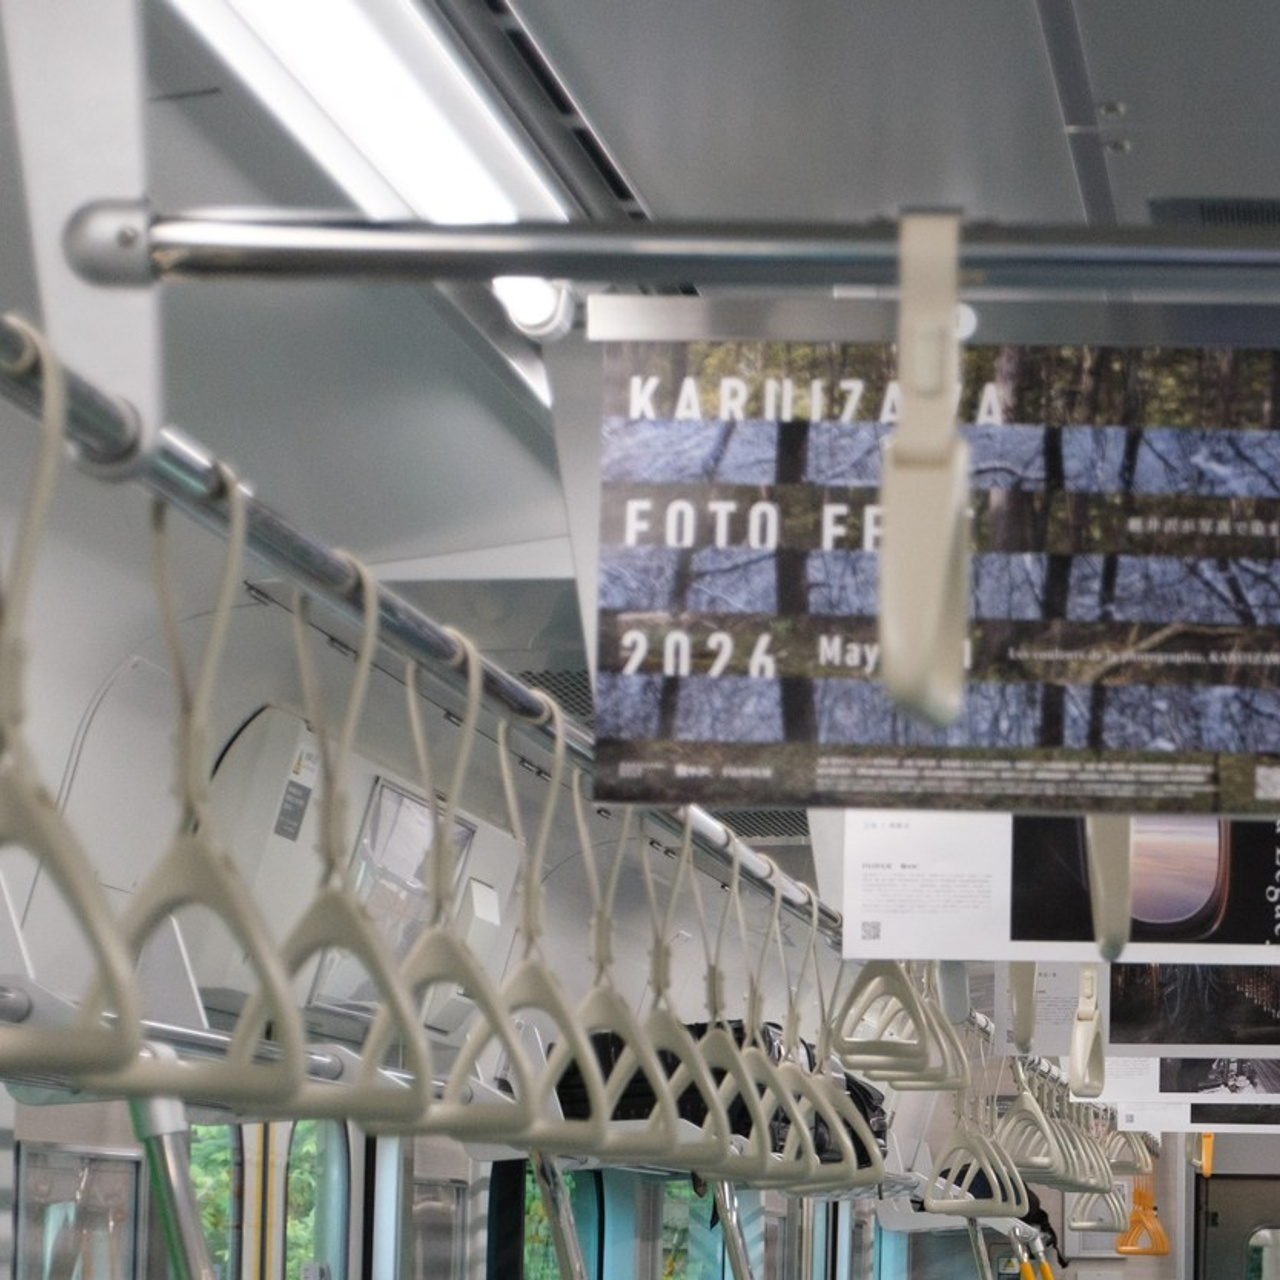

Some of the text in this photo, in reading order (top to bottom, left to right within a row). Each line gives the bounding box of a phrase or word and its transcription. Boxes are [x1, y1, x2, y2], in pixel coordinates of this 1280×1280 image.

[628, 375, 1004, 425] KARUIZAA
[625, 499, 780, 550] FOTO
[621, 630, 777, 679] 2026
[817, 634, 880, 674] May
